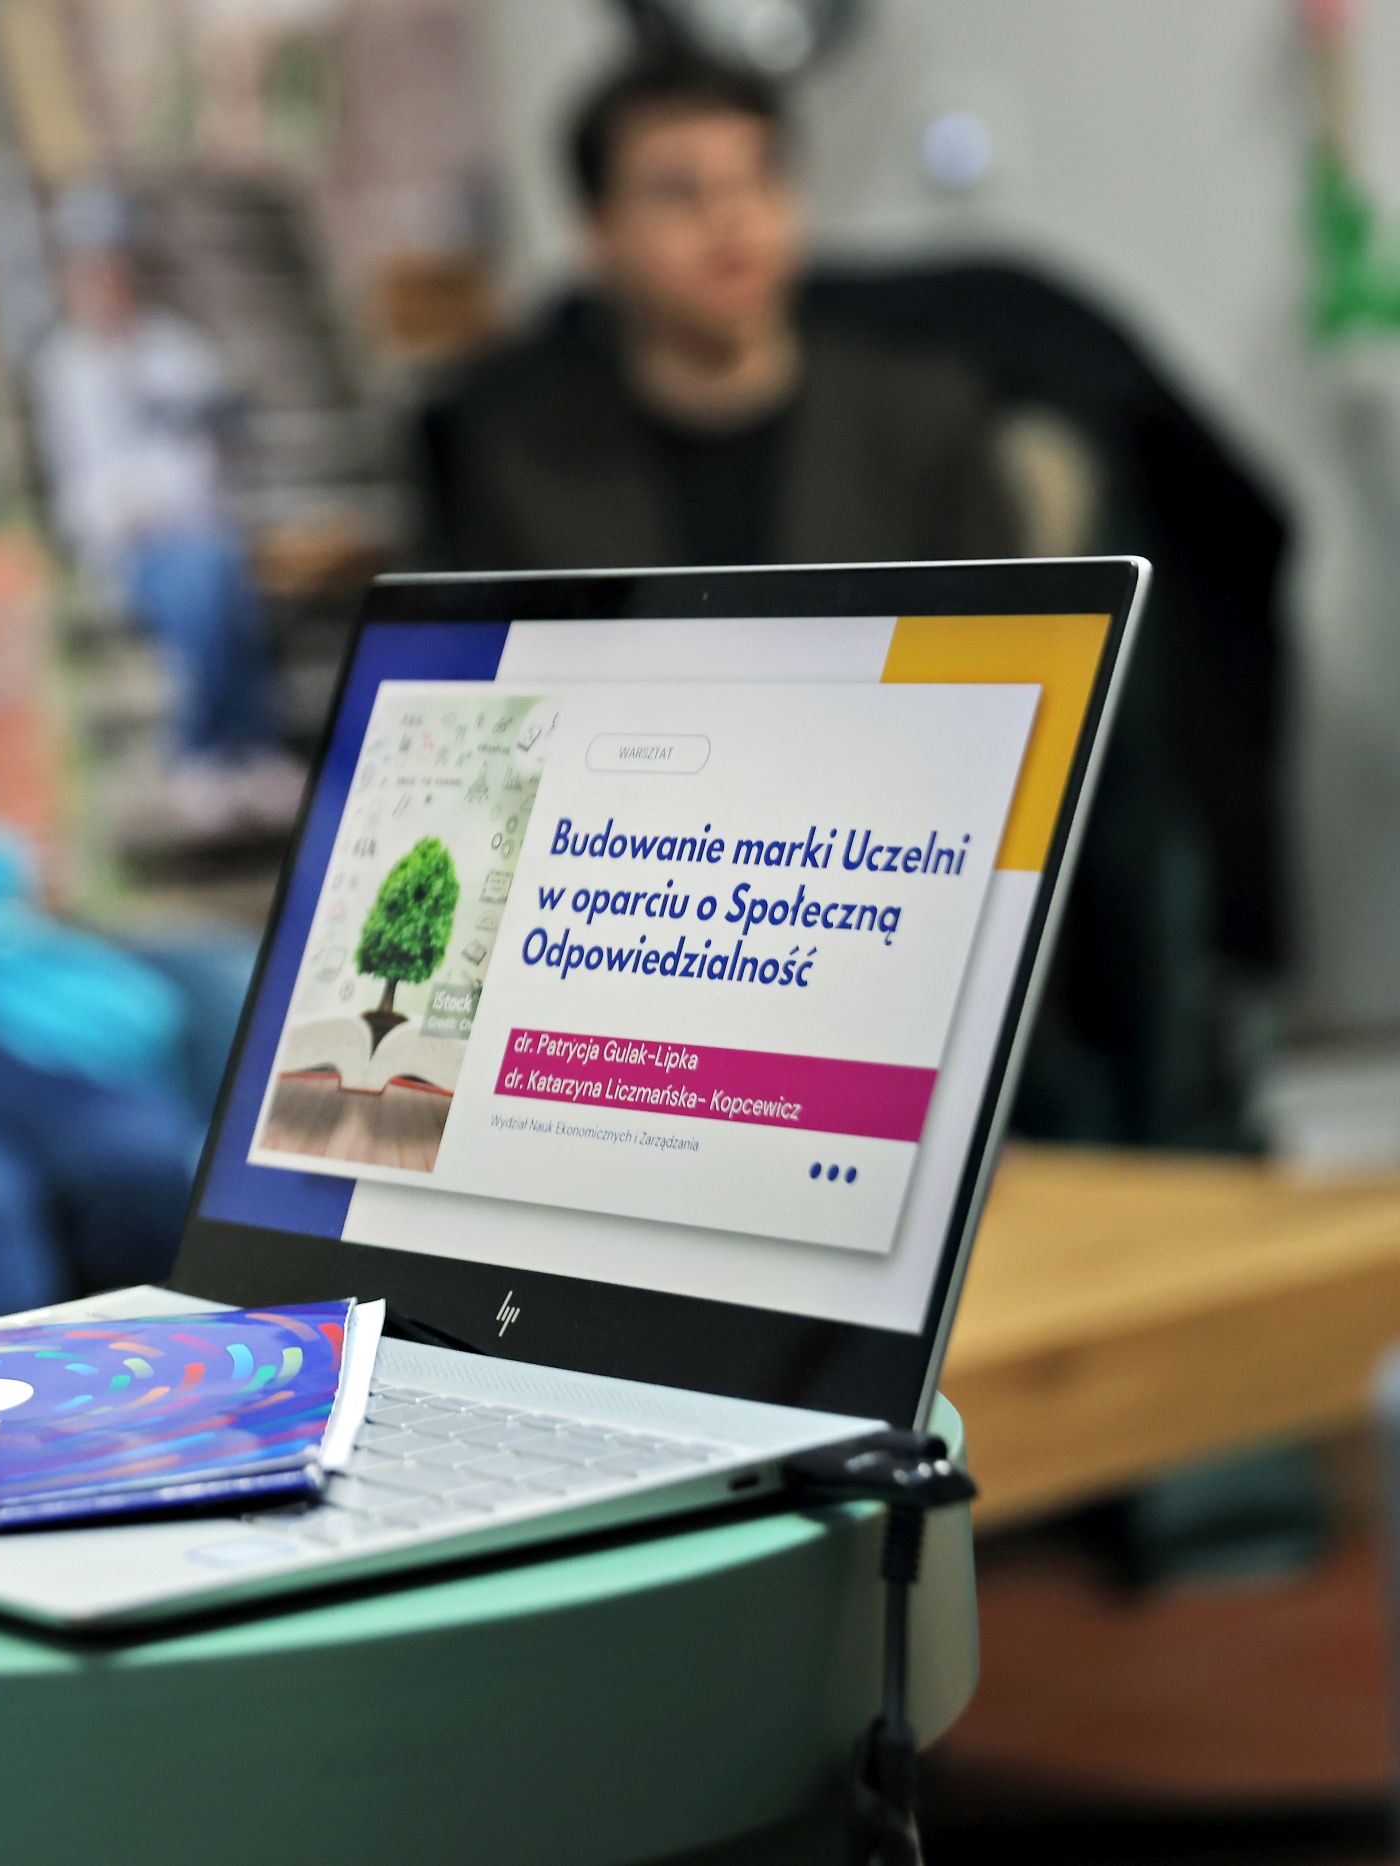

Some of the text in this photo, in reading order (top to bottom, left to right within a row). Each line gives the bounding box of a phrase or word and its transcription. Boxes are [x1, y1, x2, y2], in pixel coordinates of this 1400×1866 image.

[618, 746, 674, 760] WARSZTAT
[550, 817, 971, 876] Budowanie marki Uczelni
[538, 880, 902, 946] w oparciu o Społeczną
[521, 927, 815, 988] Odpowiedzialność
[513, 1031, 699, 1073] dr. Patrycja Gulak-Lipka
[503, 1067, 803, 1121] dr. Katarzyna Liczmańska- Kopcewicz
[489, 1114, 529, 1131] Wydział
[529, 1118, 553, 1134] Nauk
[555, 1121, 633, 1144] Ekonomicznych
[639, 1130, 700, 1151] Zarządzania
